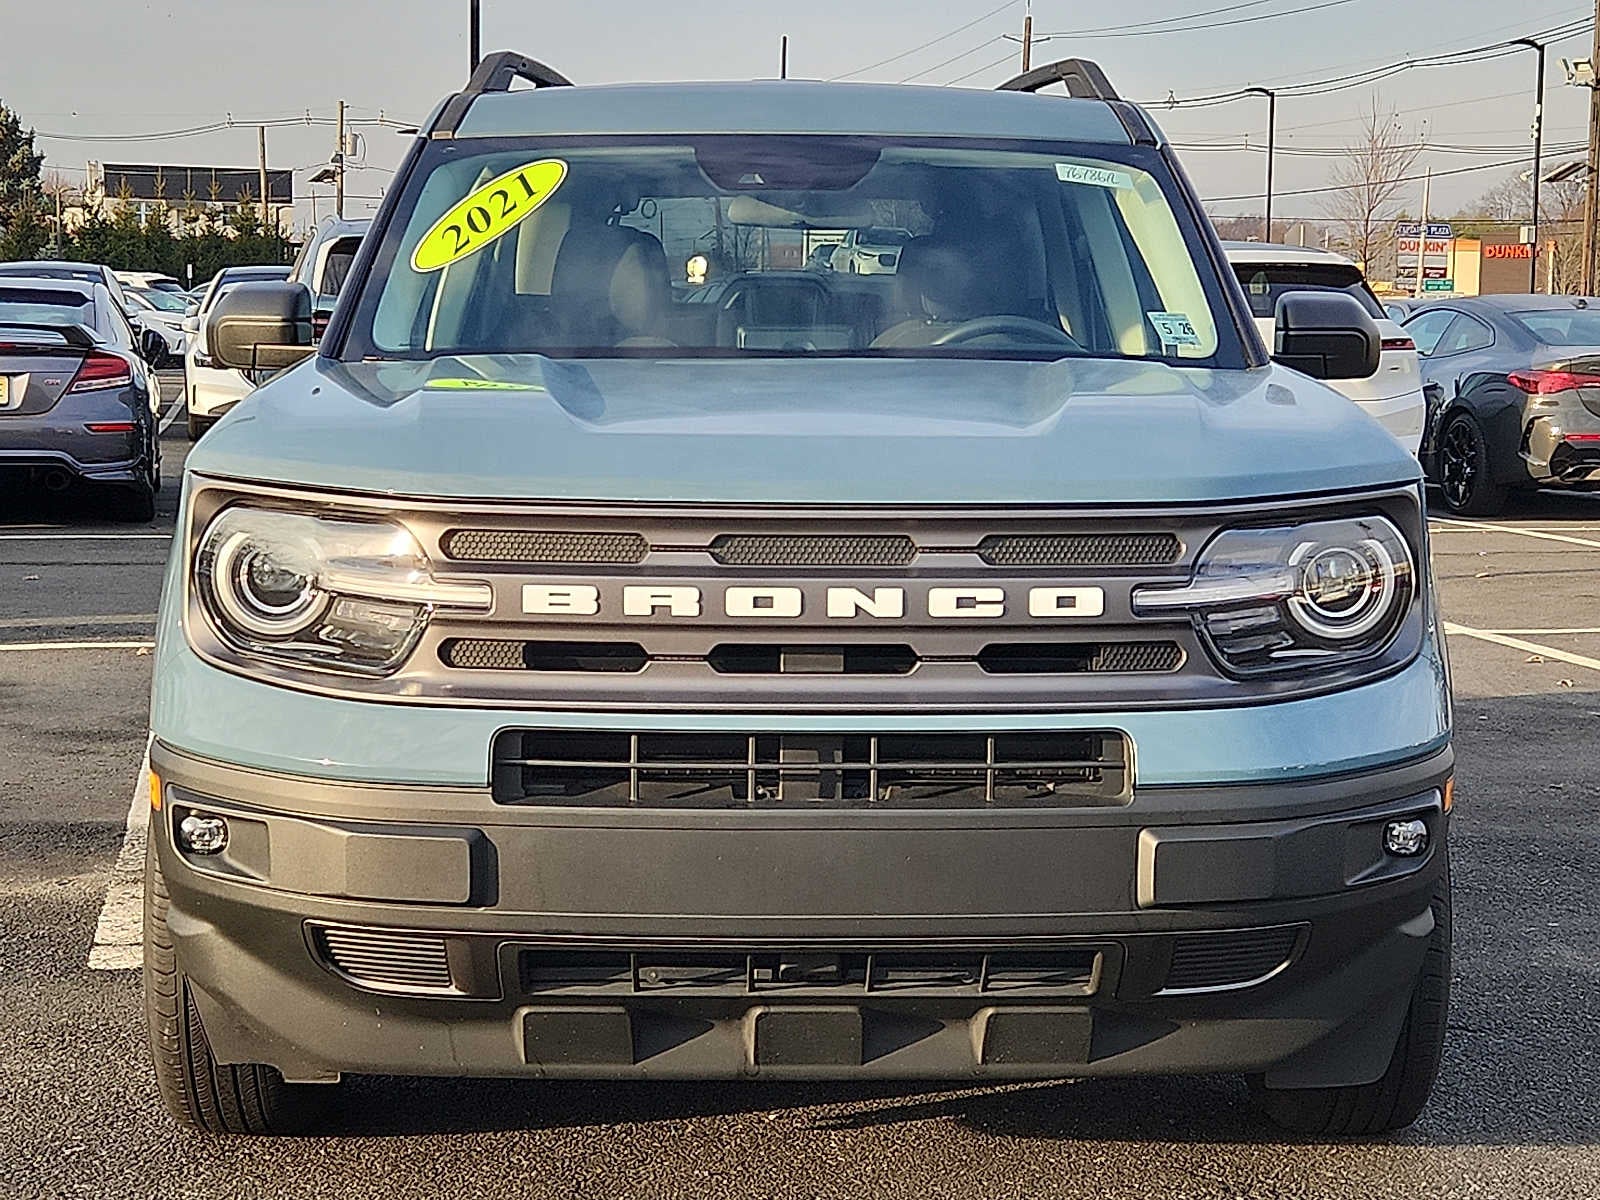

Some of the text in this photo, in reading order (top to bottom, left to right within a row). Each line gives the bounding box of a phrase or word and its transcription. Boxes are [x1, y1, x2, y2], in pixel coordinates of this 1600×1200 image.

[442, 172, 540, 256] 2021
[1161, 322, 1196, 335] 5 26
[521, 584, 1105, 618] BRONCO
